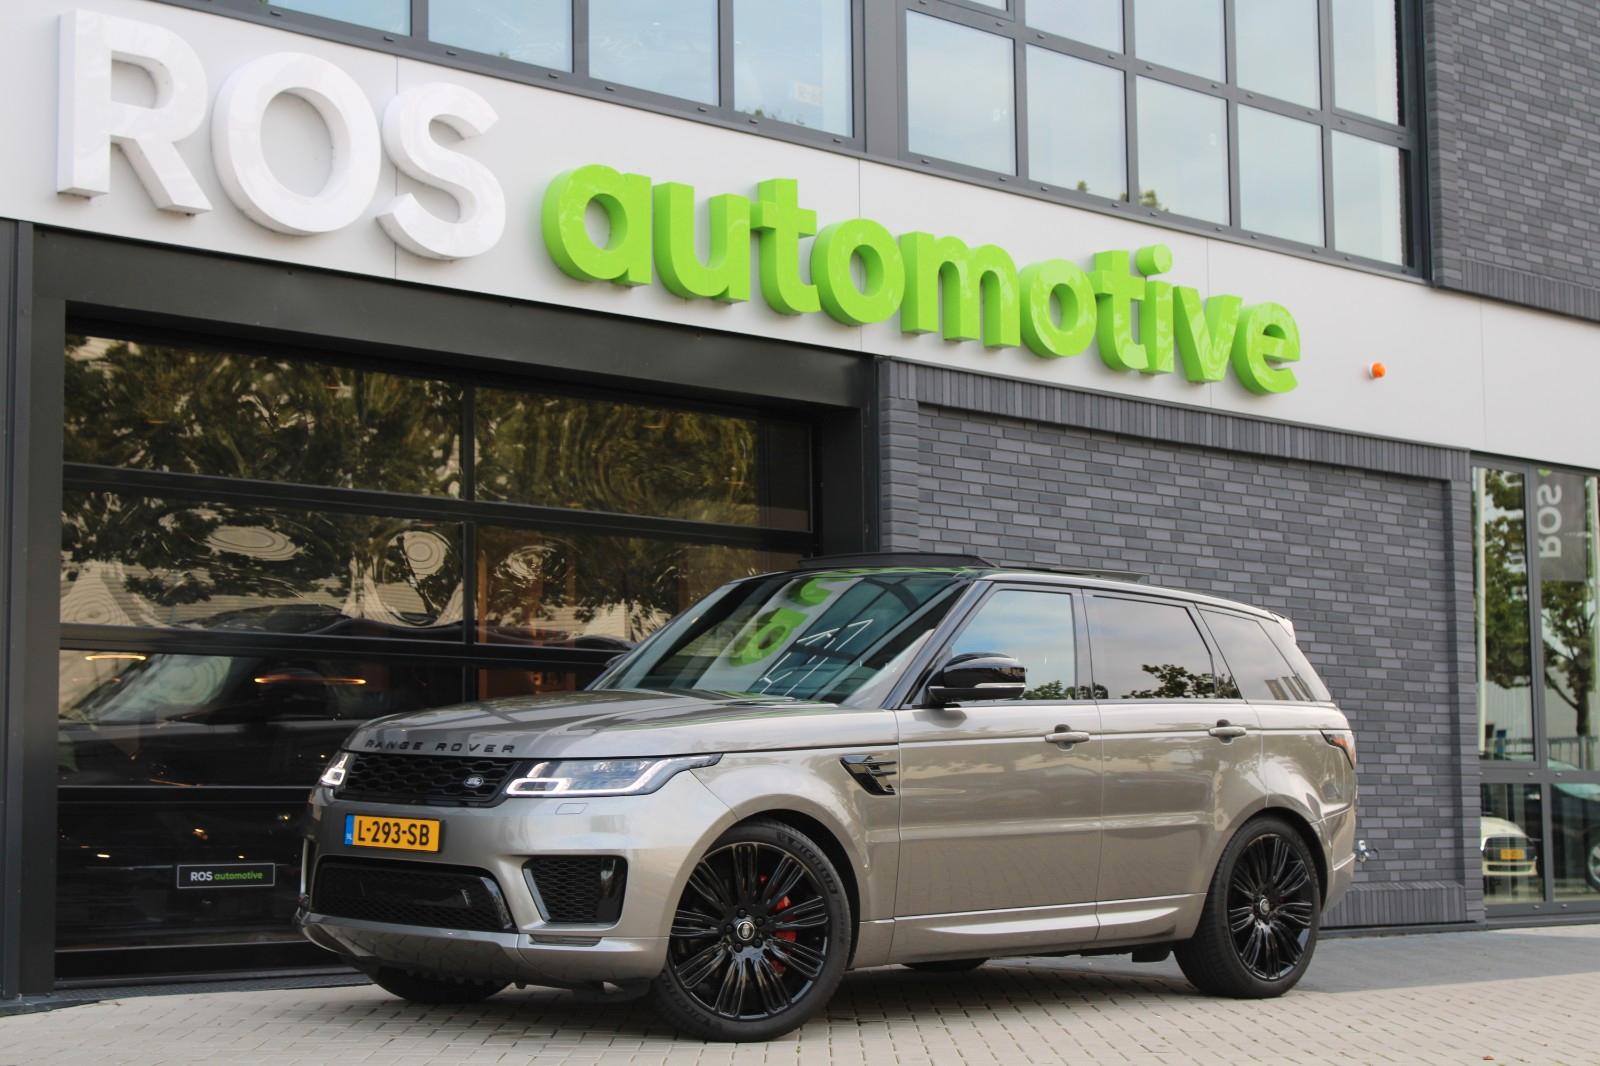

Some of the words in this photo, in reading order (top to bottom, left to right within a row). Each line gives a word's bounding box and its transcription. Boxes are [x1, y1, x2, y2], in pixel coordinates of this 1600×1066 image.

[57, 9, 506, 261] ROS
[541, 163, 1301, 395] automotive
[364, 739, 424, 751] RANGE
[435, 742, 515, 754] ROVER
[357, 820, 430, 846] L-293-SB
[190, 871, 213, 881] ROS
[214, 871, 263, 881] automotive
